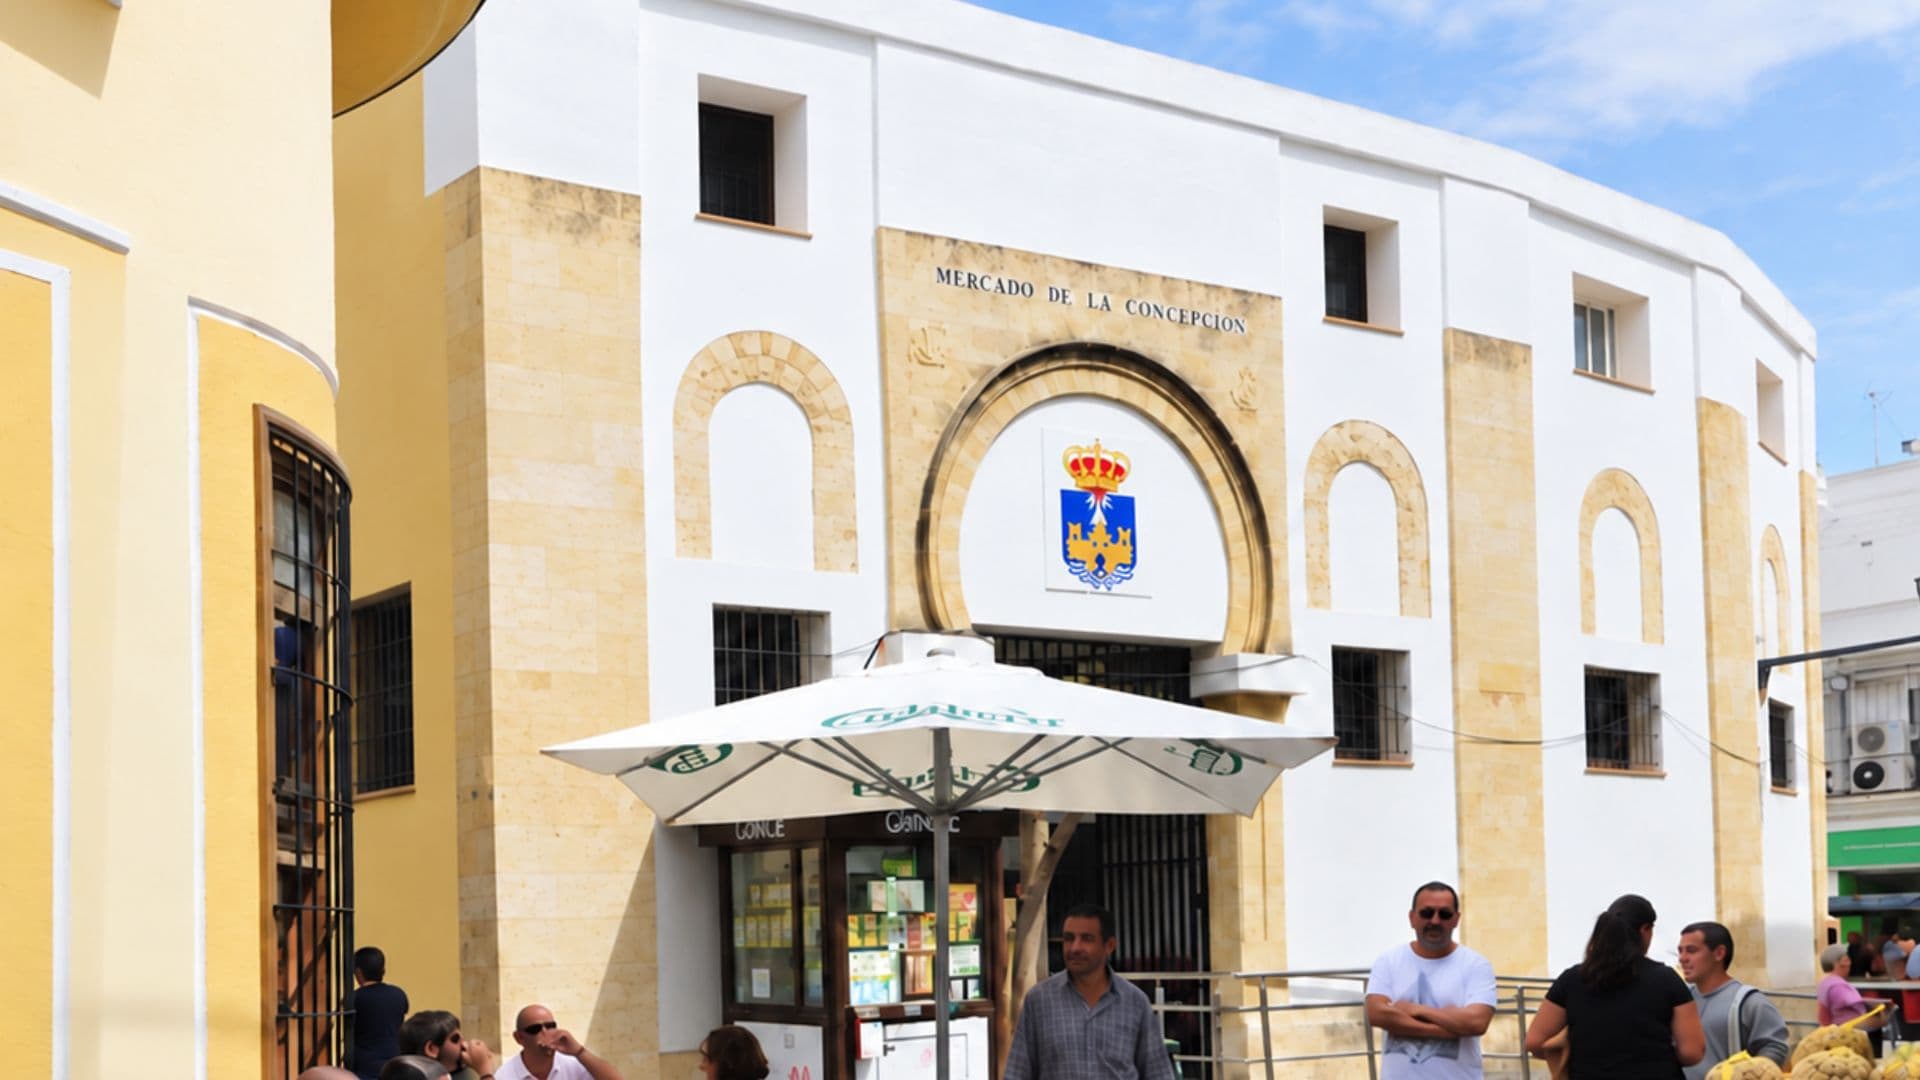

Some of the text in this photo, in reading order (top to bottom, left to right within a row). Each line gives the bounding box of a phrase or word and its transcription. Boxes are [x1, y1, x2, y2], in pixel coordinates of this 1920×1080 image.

[936, 266, 1246, 334] MERCADO DE LA CONCEPCION
